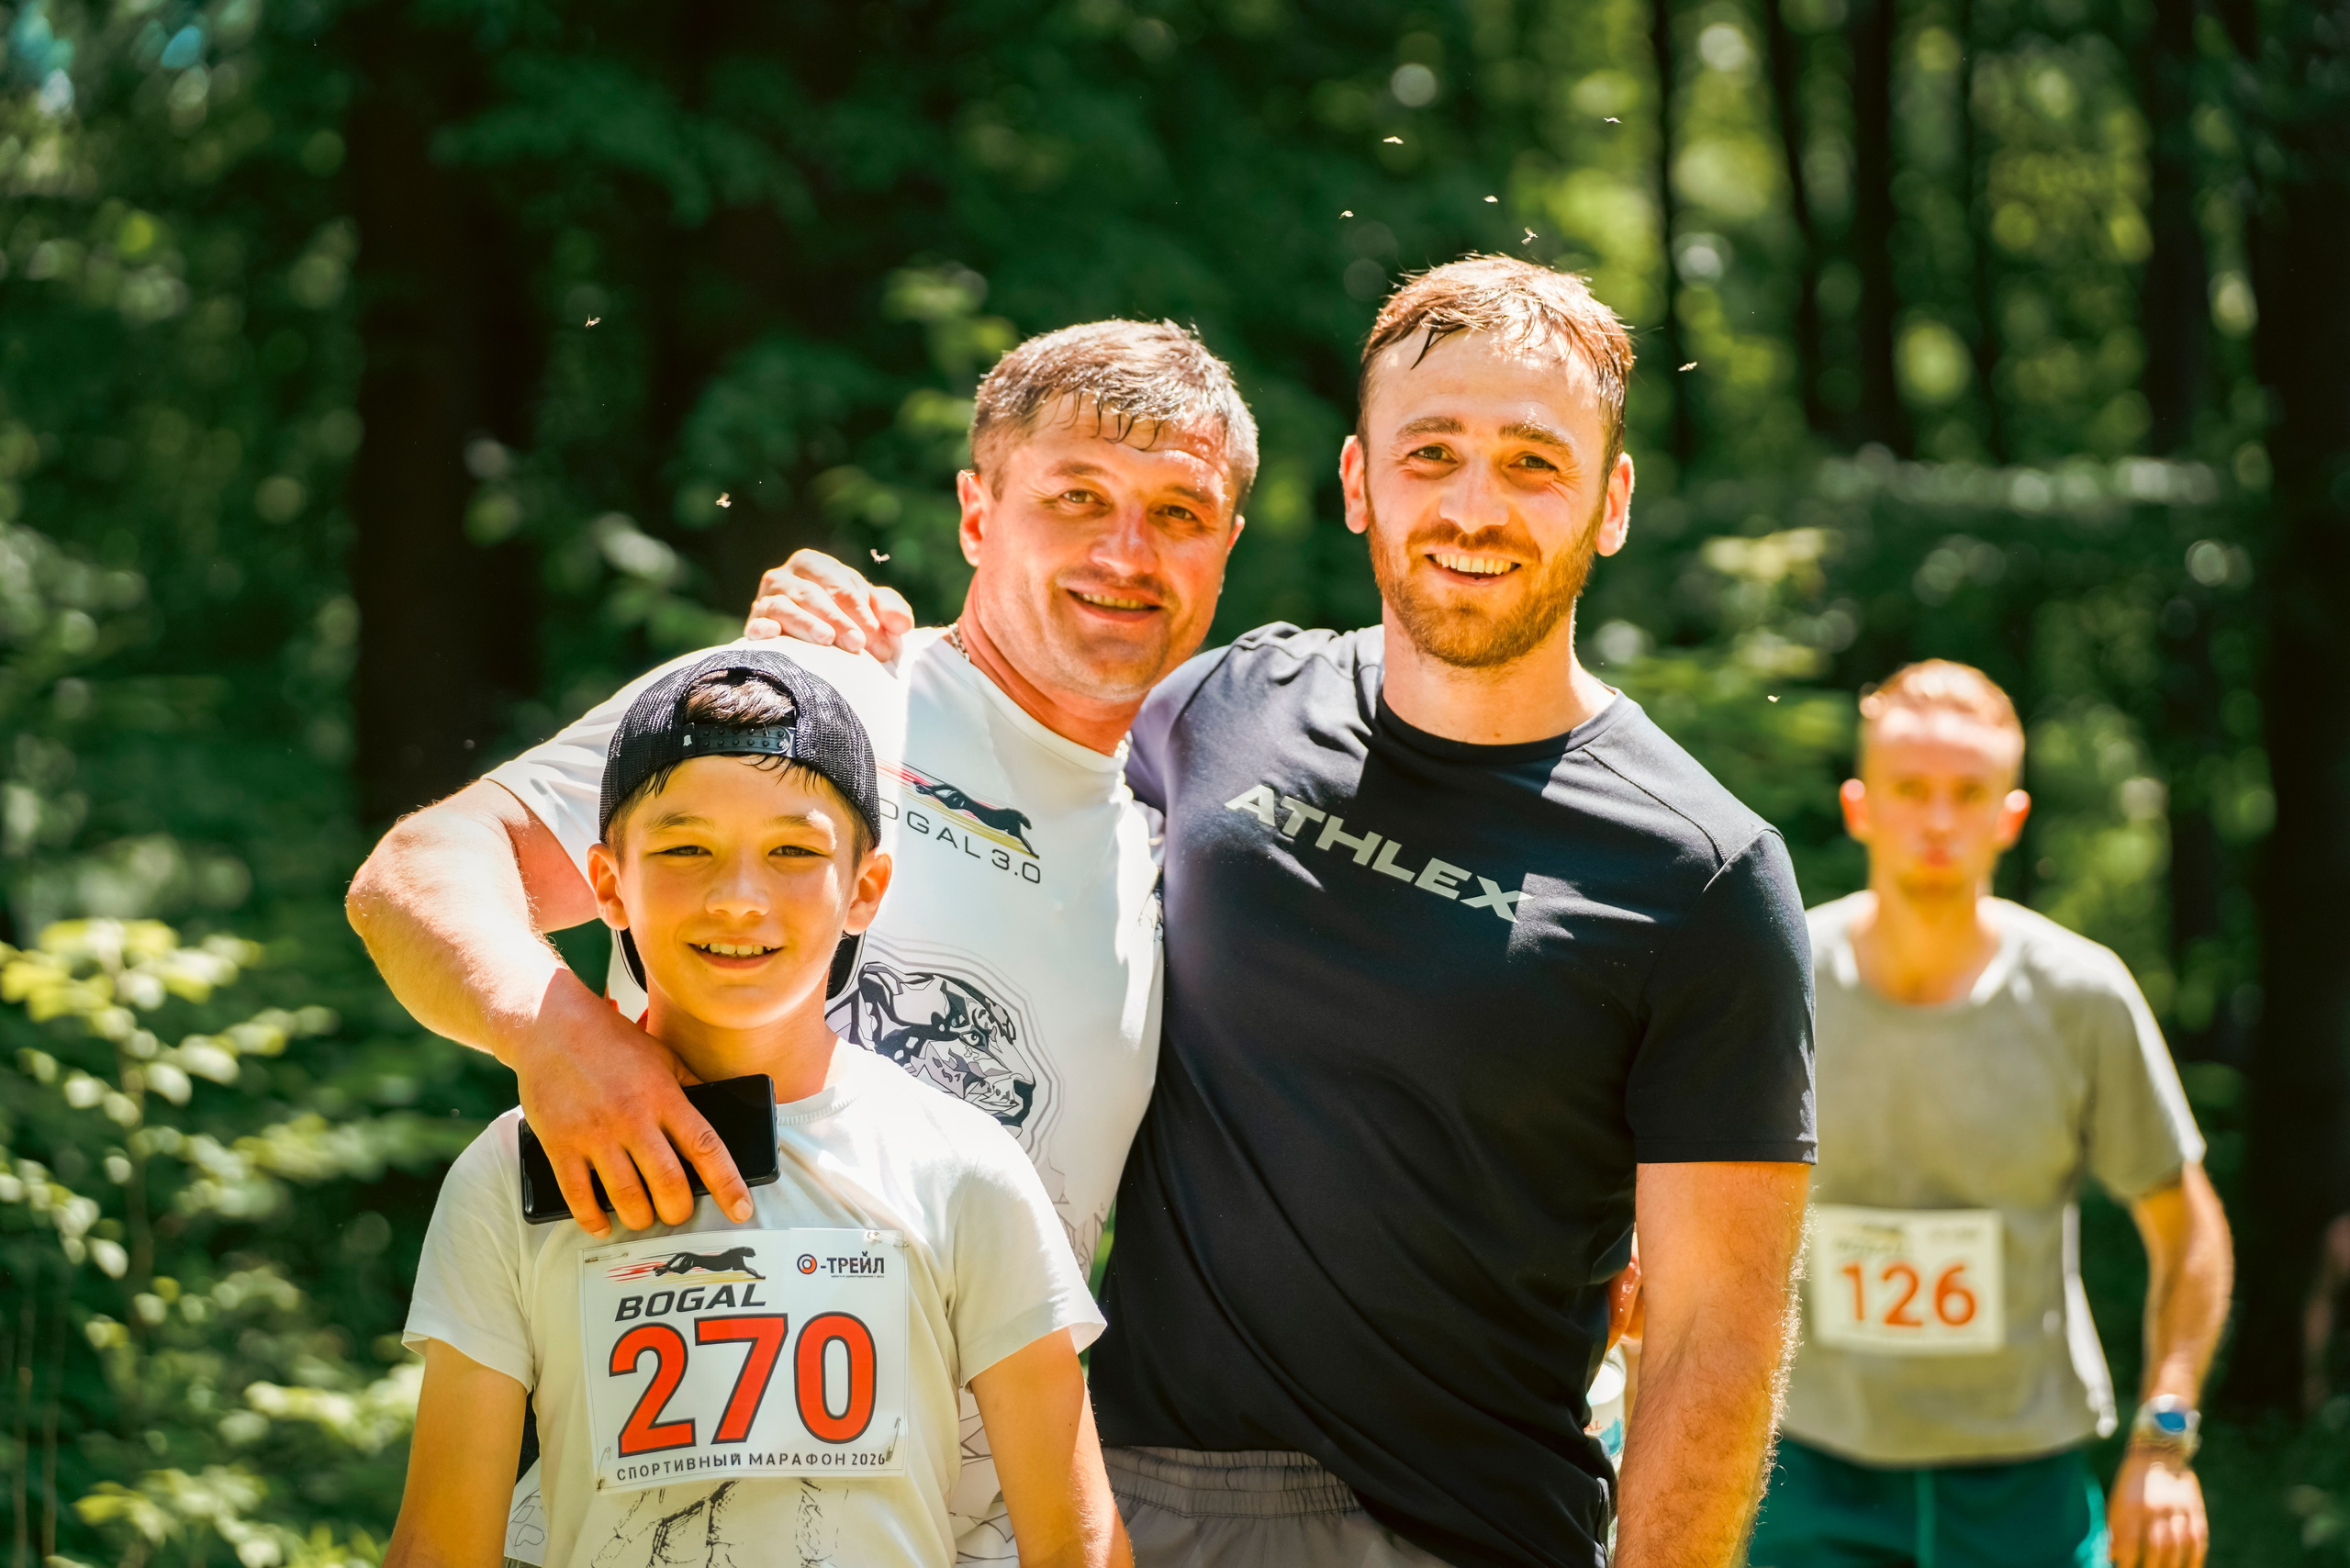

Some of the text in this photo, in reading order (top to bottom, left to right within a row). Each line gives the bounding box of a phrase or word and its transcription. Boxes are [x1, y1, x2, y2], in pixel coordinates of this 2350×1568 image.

[878, 797, 980, 859] OGAL
[1224, 784, 1534, 924] ATHLEX
[615, 1283, 767, 1322] BOGAL
[1840, 1260, 1977, 1328] 126
[609, 1311, 877, 1458] 270
[617, 1452, 886, 1481] СПОРТИВНЫЙ МАРАФОН 2026
